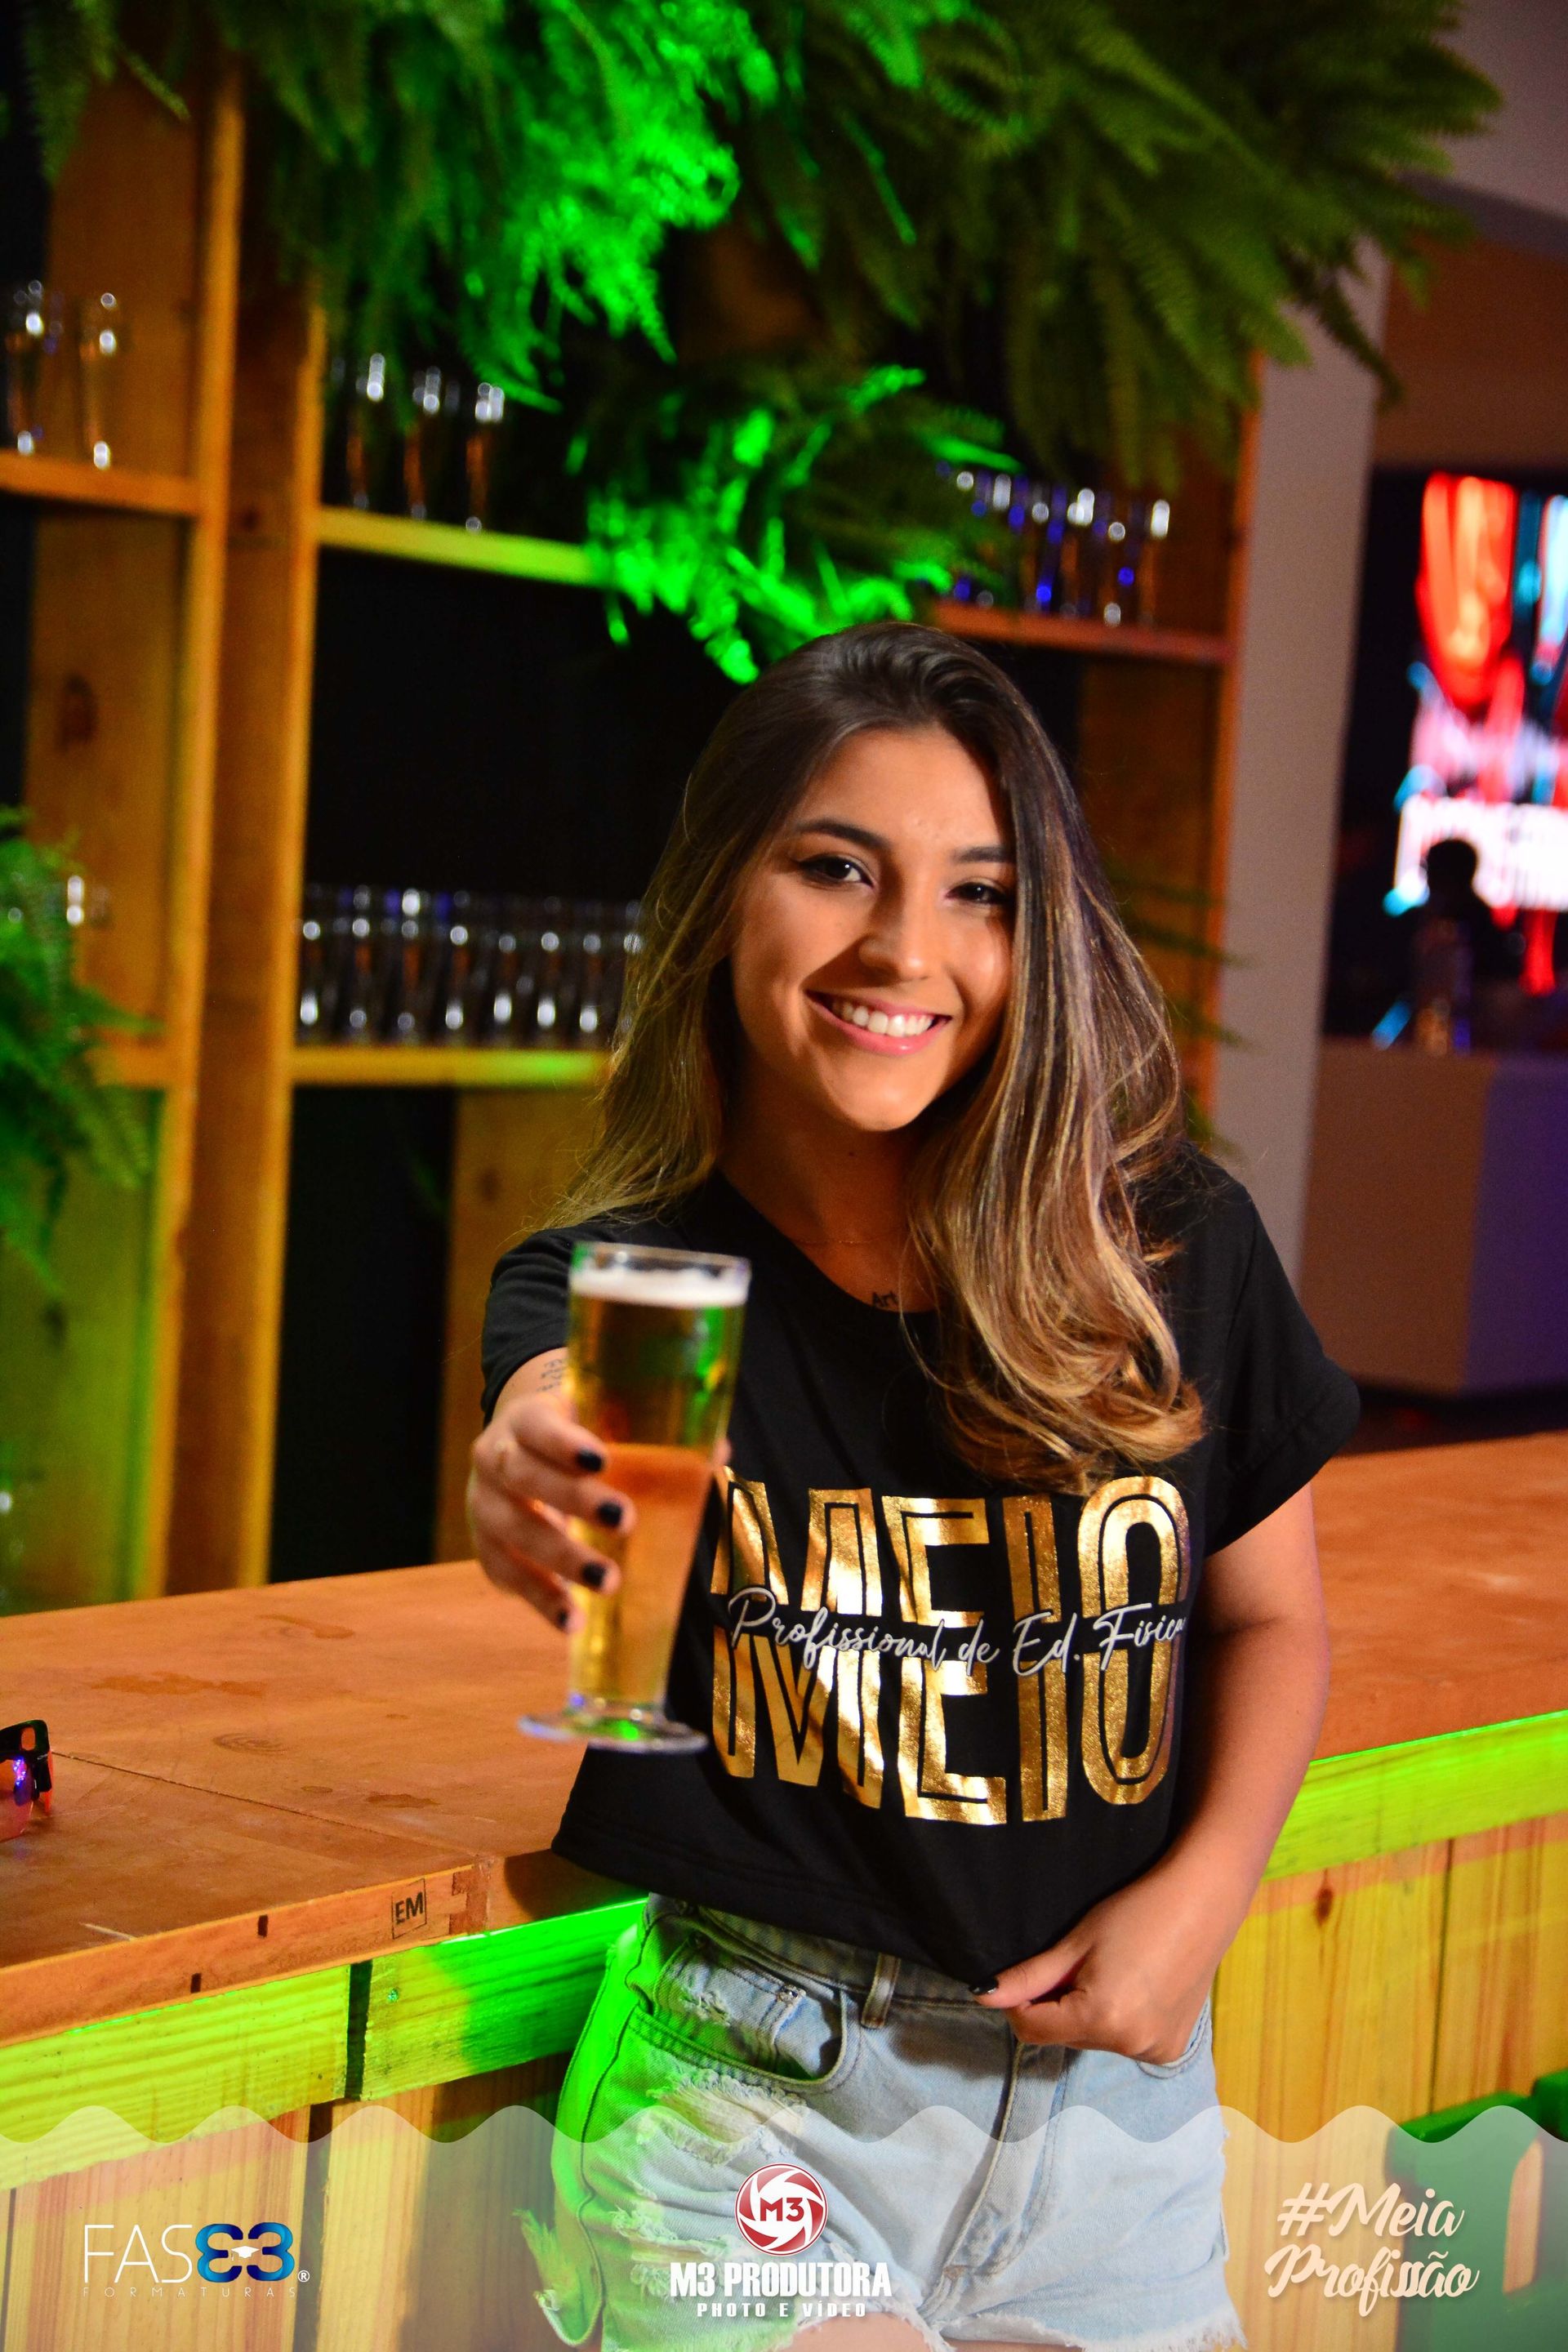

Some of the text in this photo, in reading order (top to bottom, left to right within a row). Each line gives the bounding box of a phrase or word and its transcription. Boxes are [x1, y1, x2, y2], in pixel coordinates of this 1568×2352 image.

[709, 1465, 1191, 1826] MEIO
[727, 1587, 947, 1671] Profissional
[957, 1619, 999, 1677] de
[1012, 1611, 1080, 1677] Ed.
[394, 1891, 424, 1925] EM
